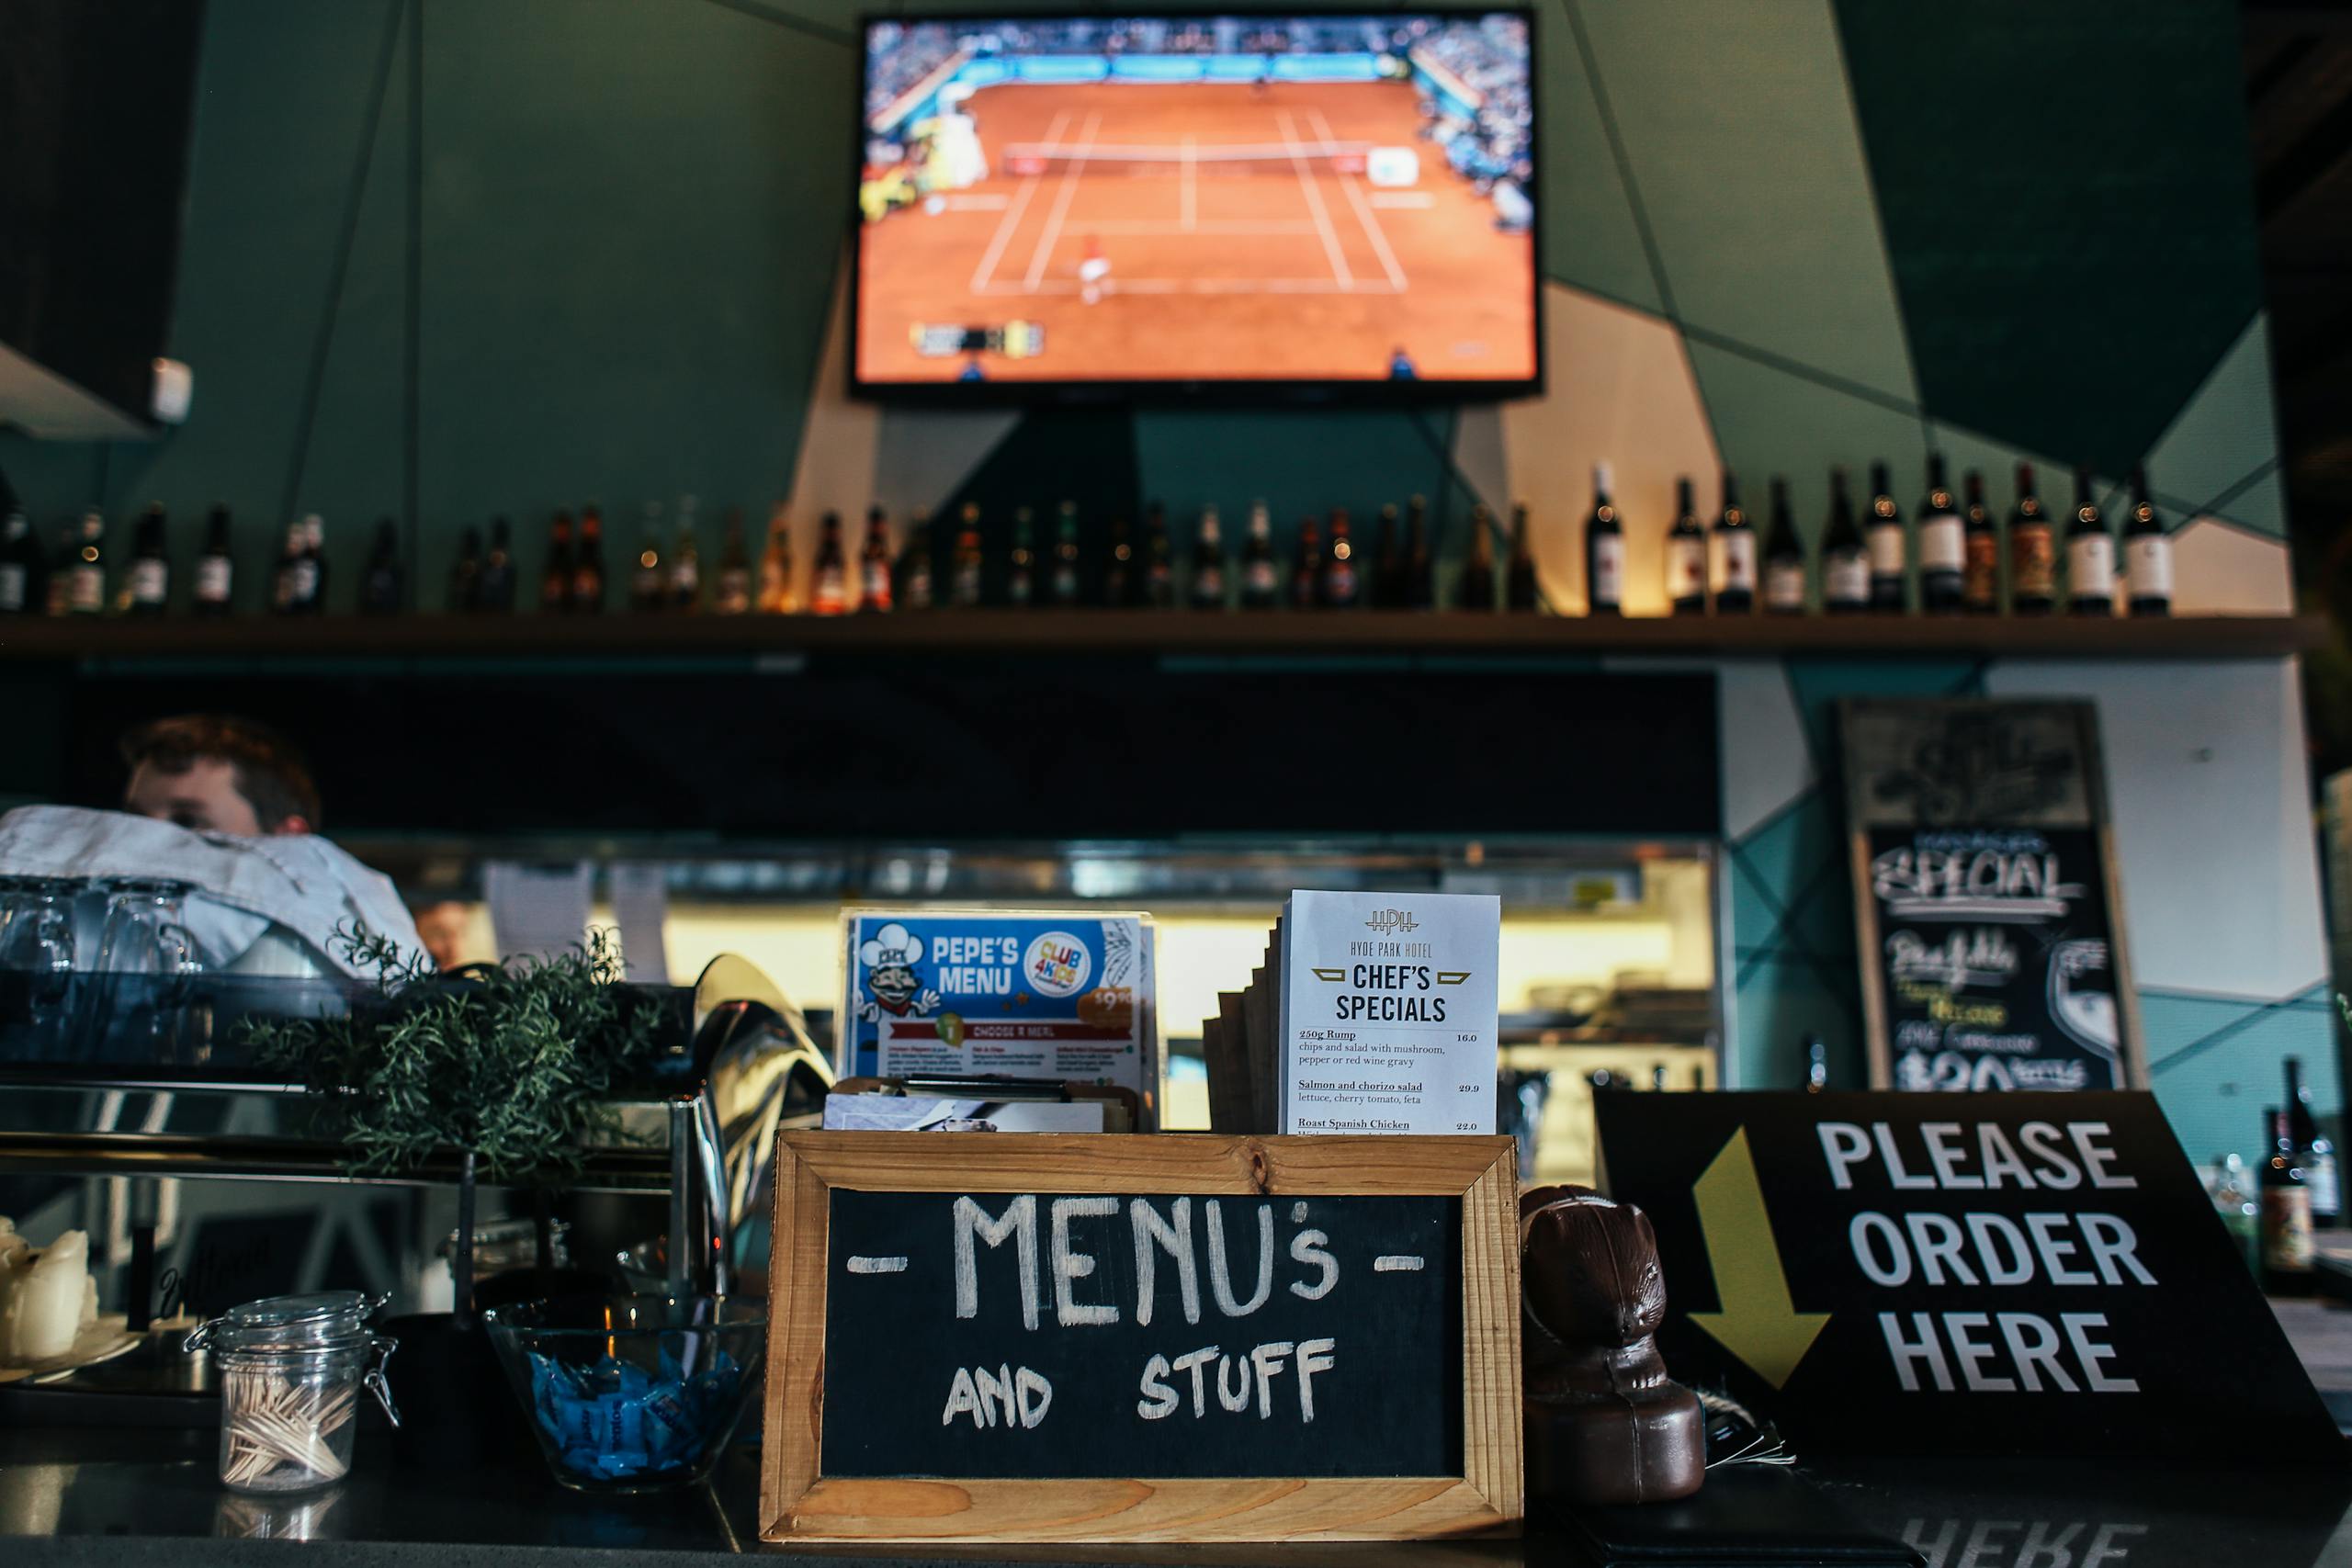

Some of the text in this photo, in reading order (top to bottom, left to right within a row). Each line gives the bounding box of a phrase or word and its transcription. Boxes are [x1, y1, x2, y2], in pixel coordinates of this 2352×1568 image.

[1872, 849, 2087, 898] SPECIAL
[879, 949, 907, 964] PEPE
[933, 937, 1019, 964] PEPE'S
[1040, 941, 1081, 968] CLUB
[1351, 942, 1432, 958] HYDE PARK HOTEL
[939, 967, 1011, 995] MENU
[1353, 964, 1430, 990] CHEF'S
[1336, 995, 1445, 1022] SPECIALS
[974, 1026, 1014, 1037] CHOOSE
[1299, 1030, 1356, 1041] 250g Rump
[1457, 1034, 1477, 1043] 16.0
[1299, 1042, 1445, 1055] chips and salad with mushroom,
[1299, 1056, 1330, 1066] pepper
[1345, 1055, 1361, 1065] red
[1363, 1056, 1385, 1065] wine
[1387, 1058, 1414, 1068] gravy
[1298, 1079, 1422, 1092] Salmon and chorizo salad
[1459, 1085, 1479, 1093] 29.9
[1298, 1092, 1420, 1105] lettuce, cherry tomato, feta
[1298, 1118, 1409, 1130] Roast Spanish Chicken
[1456, 1122, 1477, 1131] 22.0
[1816, 1122, 2138, 1190] PLEASE
[1849, 1211, 2158, 1287] ORDER
[1879, 1312, 2140, 1393] HERE
[943, 1337, 1336, 1429] AND STUFF
